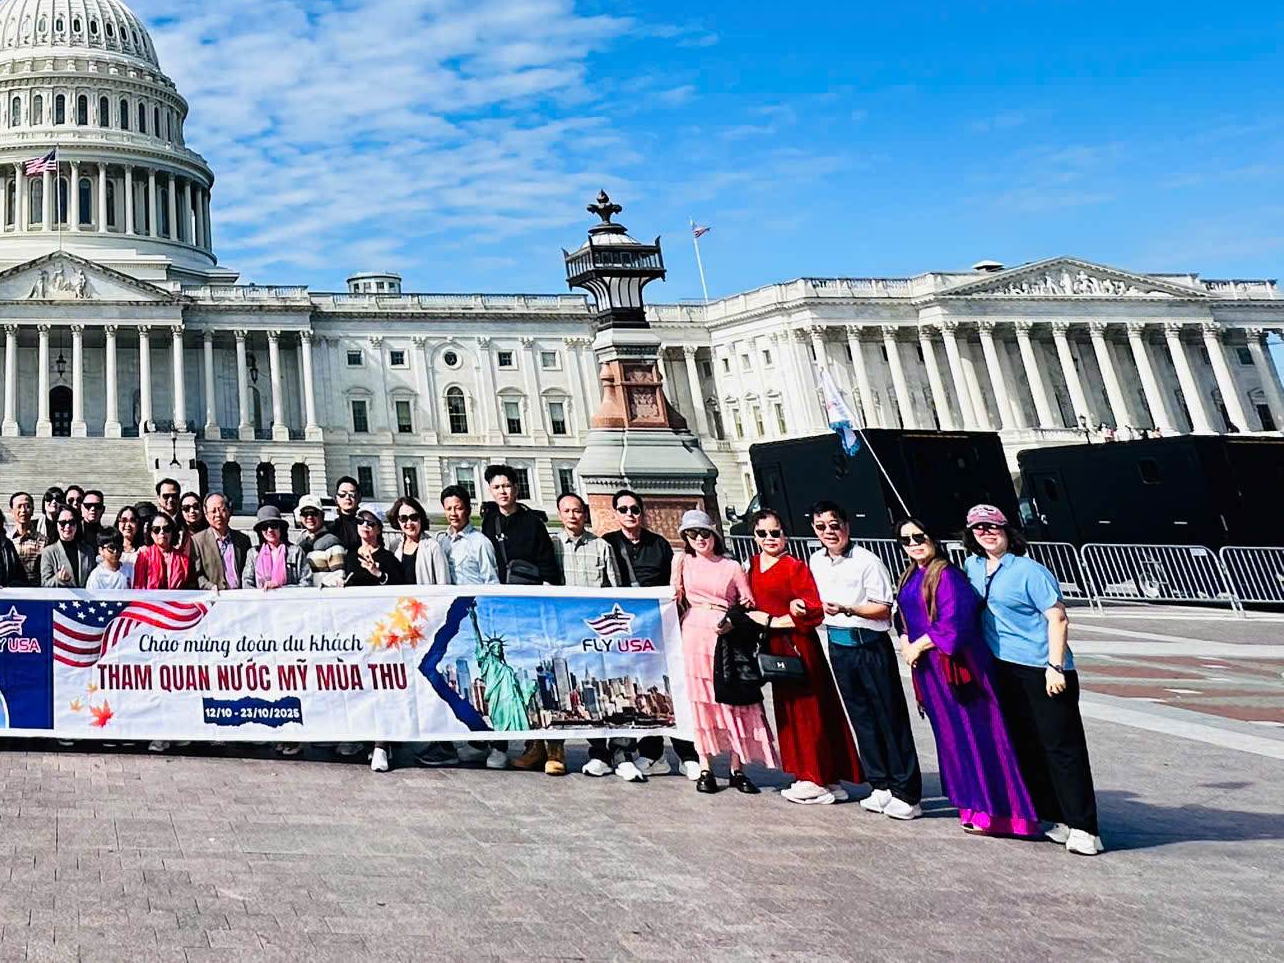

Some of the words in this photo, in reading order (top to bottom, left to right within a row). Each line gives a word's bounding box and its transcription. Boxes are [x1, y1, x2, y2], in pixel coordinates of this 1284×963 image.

[7, 637, 41, 654] USA
[139, 633, 179, 653] Chào
[183, 634, 230, 658] mừng
[235, 634, 278, 653] đoàn
[282, 634, 305, 652] du
[309, 632, 364, 652] khách
[582, 637, 612, 653] FLY
[617, 638, 655, 653] USA
[97, 664, 153, 690] THAM
[159, 664, 211, 693] QUAN
[217, 658, 271, 691] NƯỚC
[277, 658, 308, 691] MỸ
[315, 657, 364, 691] MÙA
[367, 663, 408, 690] THU
[204, 707, 233, 718] 12/10
[240, 708, 300, 719] 23/10/2025
